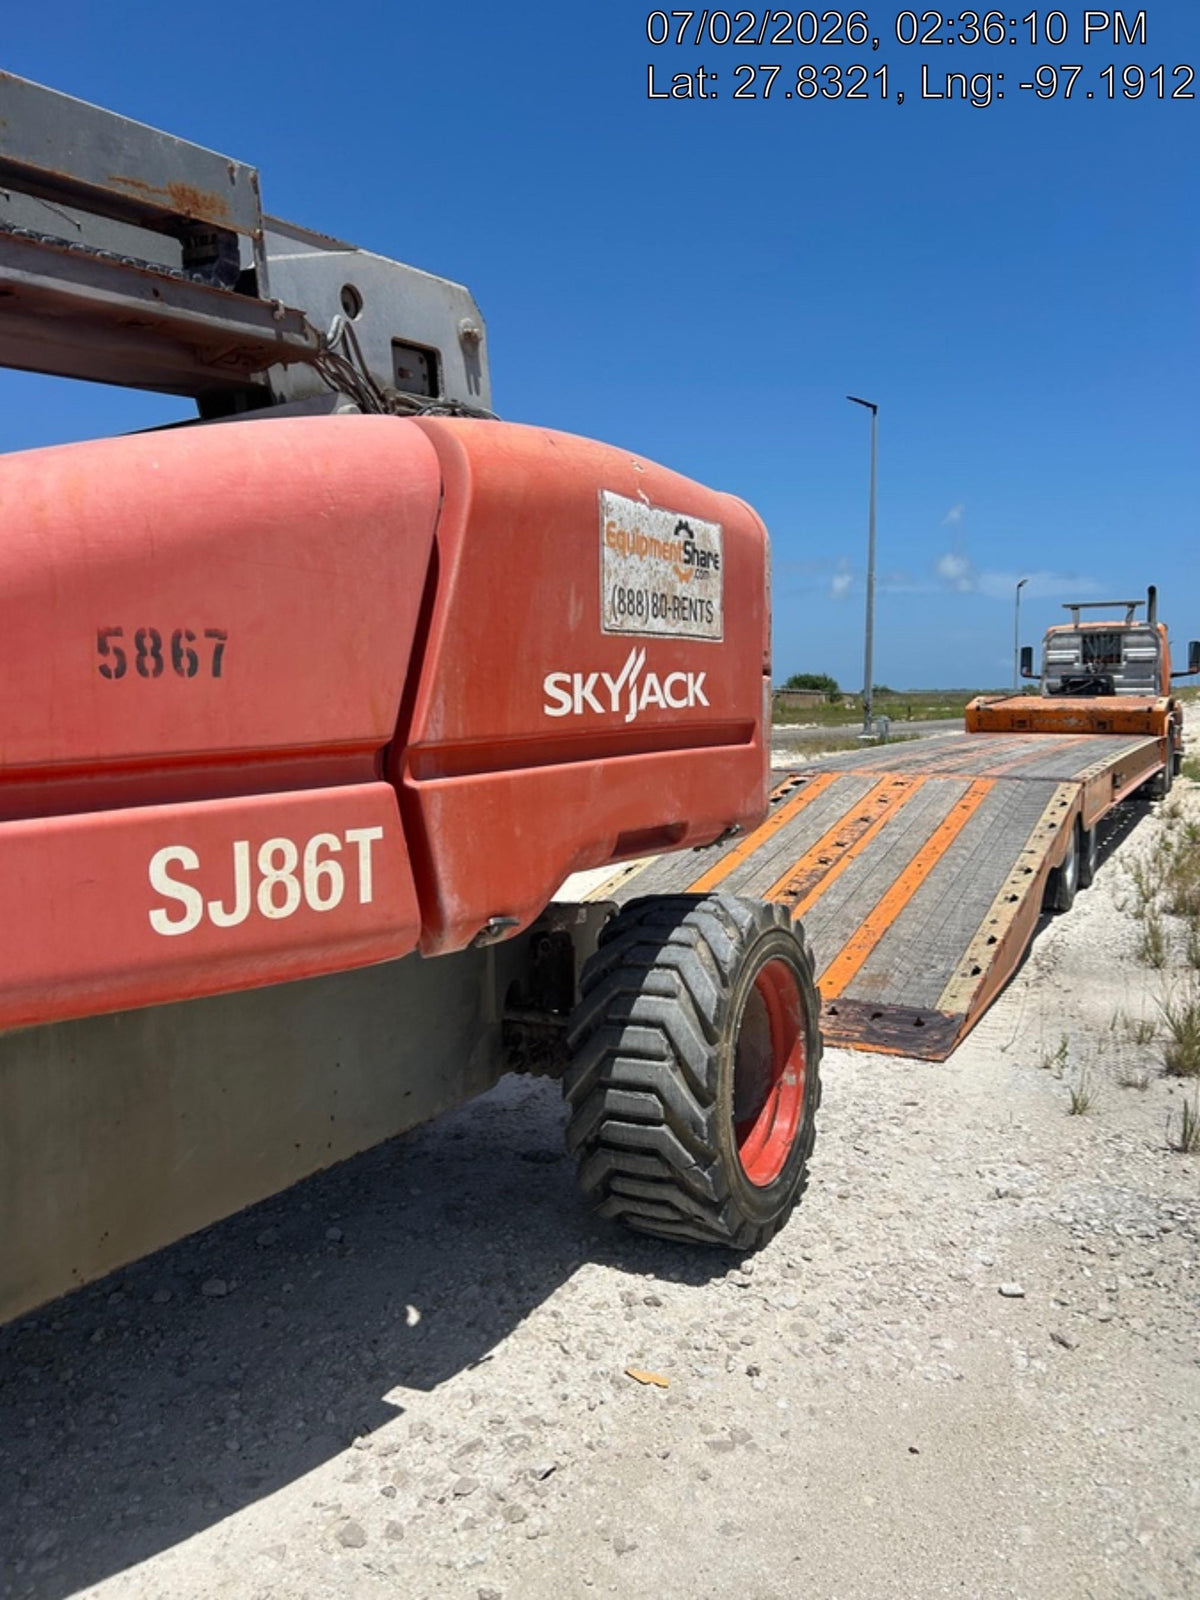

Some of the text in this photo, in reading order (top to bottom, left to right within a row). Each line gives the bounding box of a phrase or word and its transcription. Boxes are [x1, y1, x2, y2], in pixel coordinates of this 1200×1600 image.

[97, 627, 228, 680] 5867
[543, 647, 710, 723] SKYJACK
[148, 826, 383, 936] SJ86T
